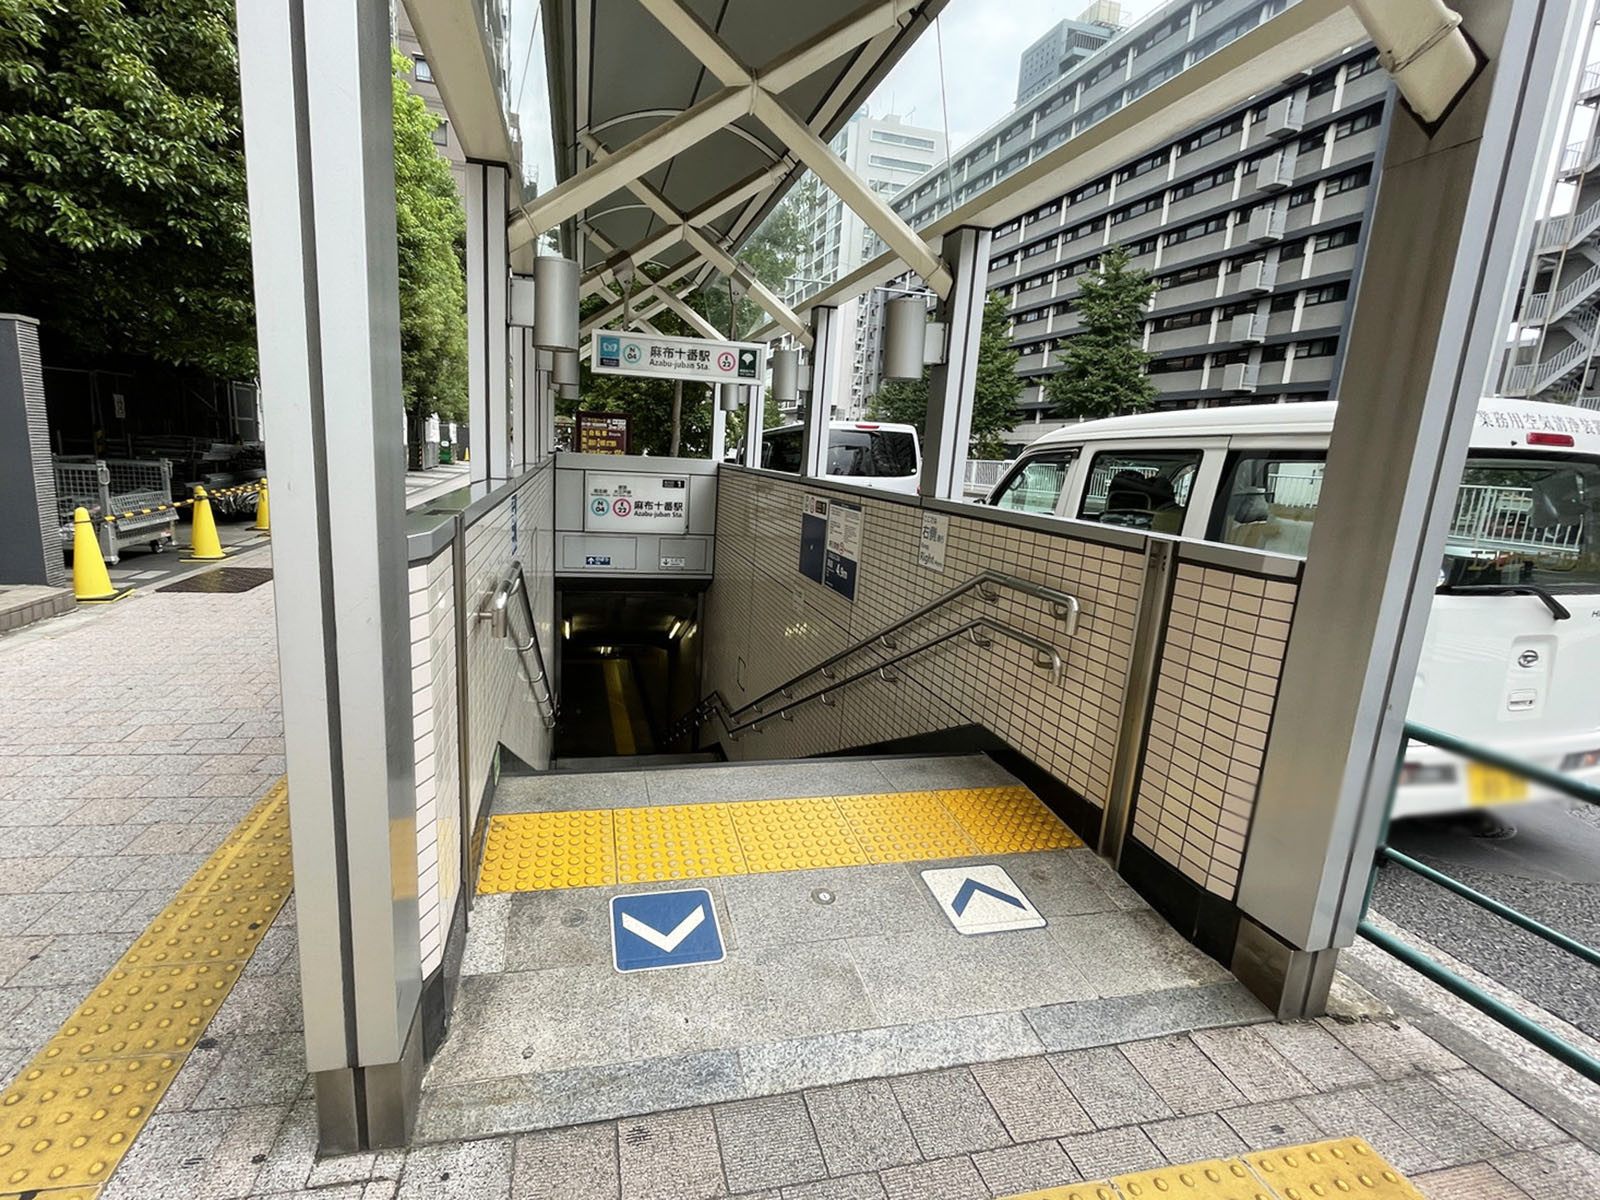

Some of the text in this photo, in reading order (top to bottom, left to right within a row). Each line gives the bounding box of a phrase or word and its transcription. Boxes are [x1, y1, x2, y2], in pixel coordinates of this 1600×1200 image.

[650, 346, 710, 362] 麻布十番駅
[649, 359, 695, 370] Azabu-juban
[634, 500, 683, 511] 麻布十番駅
